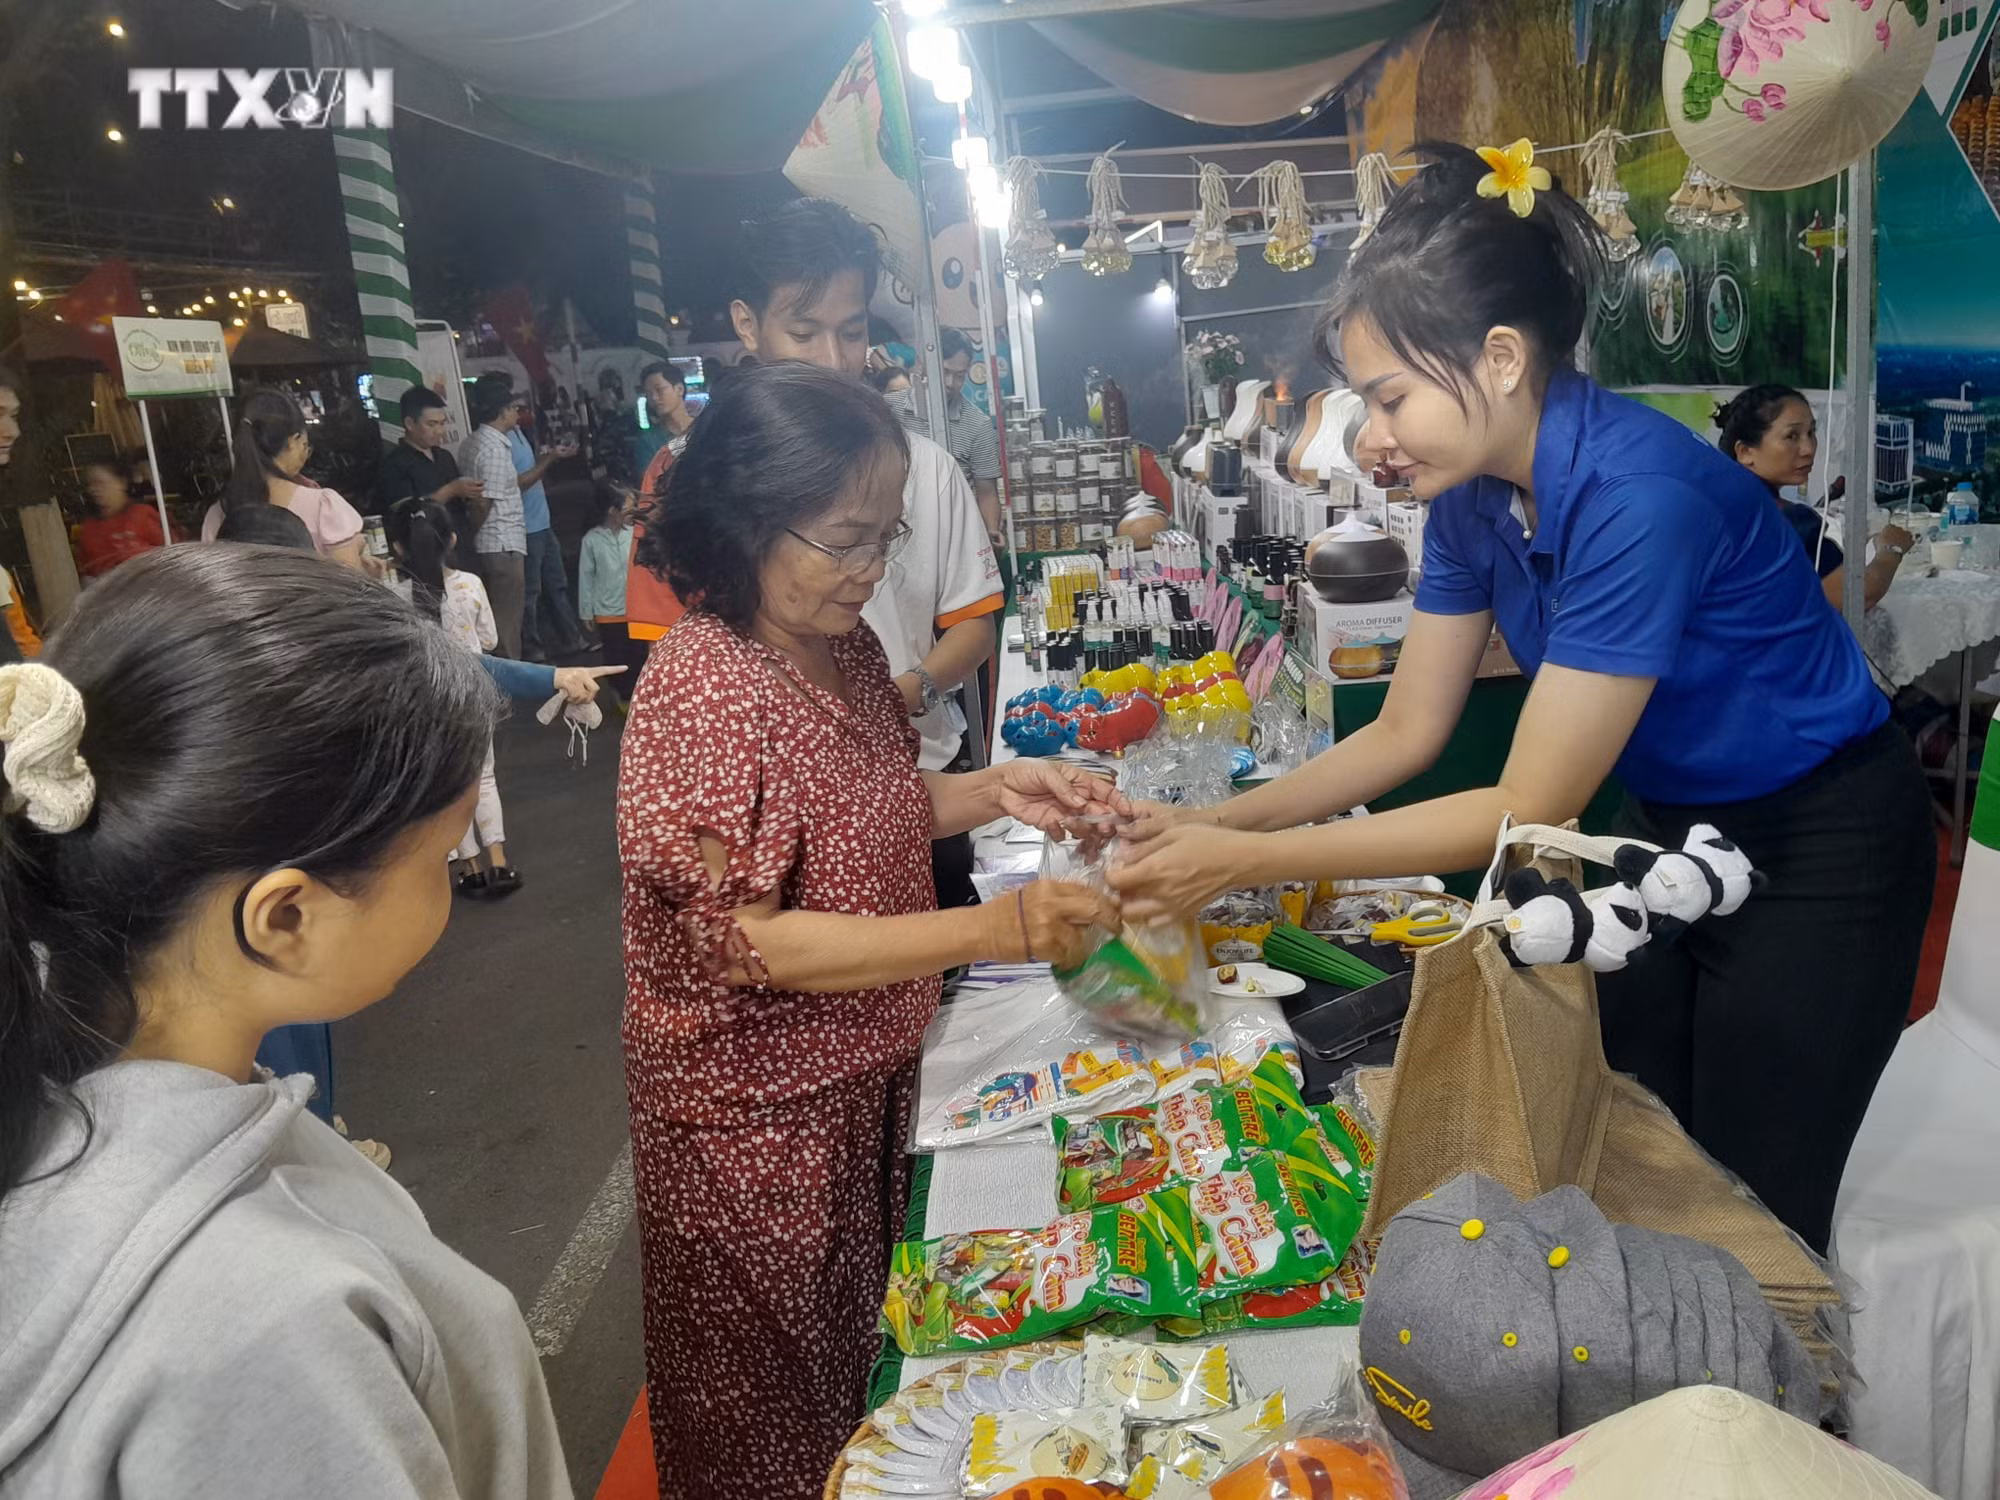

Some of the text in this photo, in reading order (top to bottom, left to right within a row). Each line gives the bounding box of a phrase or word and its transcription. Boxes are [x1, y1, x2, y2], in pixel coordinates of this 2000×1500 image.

[1336, 618, 1365, 628] AROMA
[1365, 616, 1403, 626] DIFFUSER
[1217, 1215, 1261, 1278] Cẩm
[1131, 1371, 1163, 1385] Vitravel
